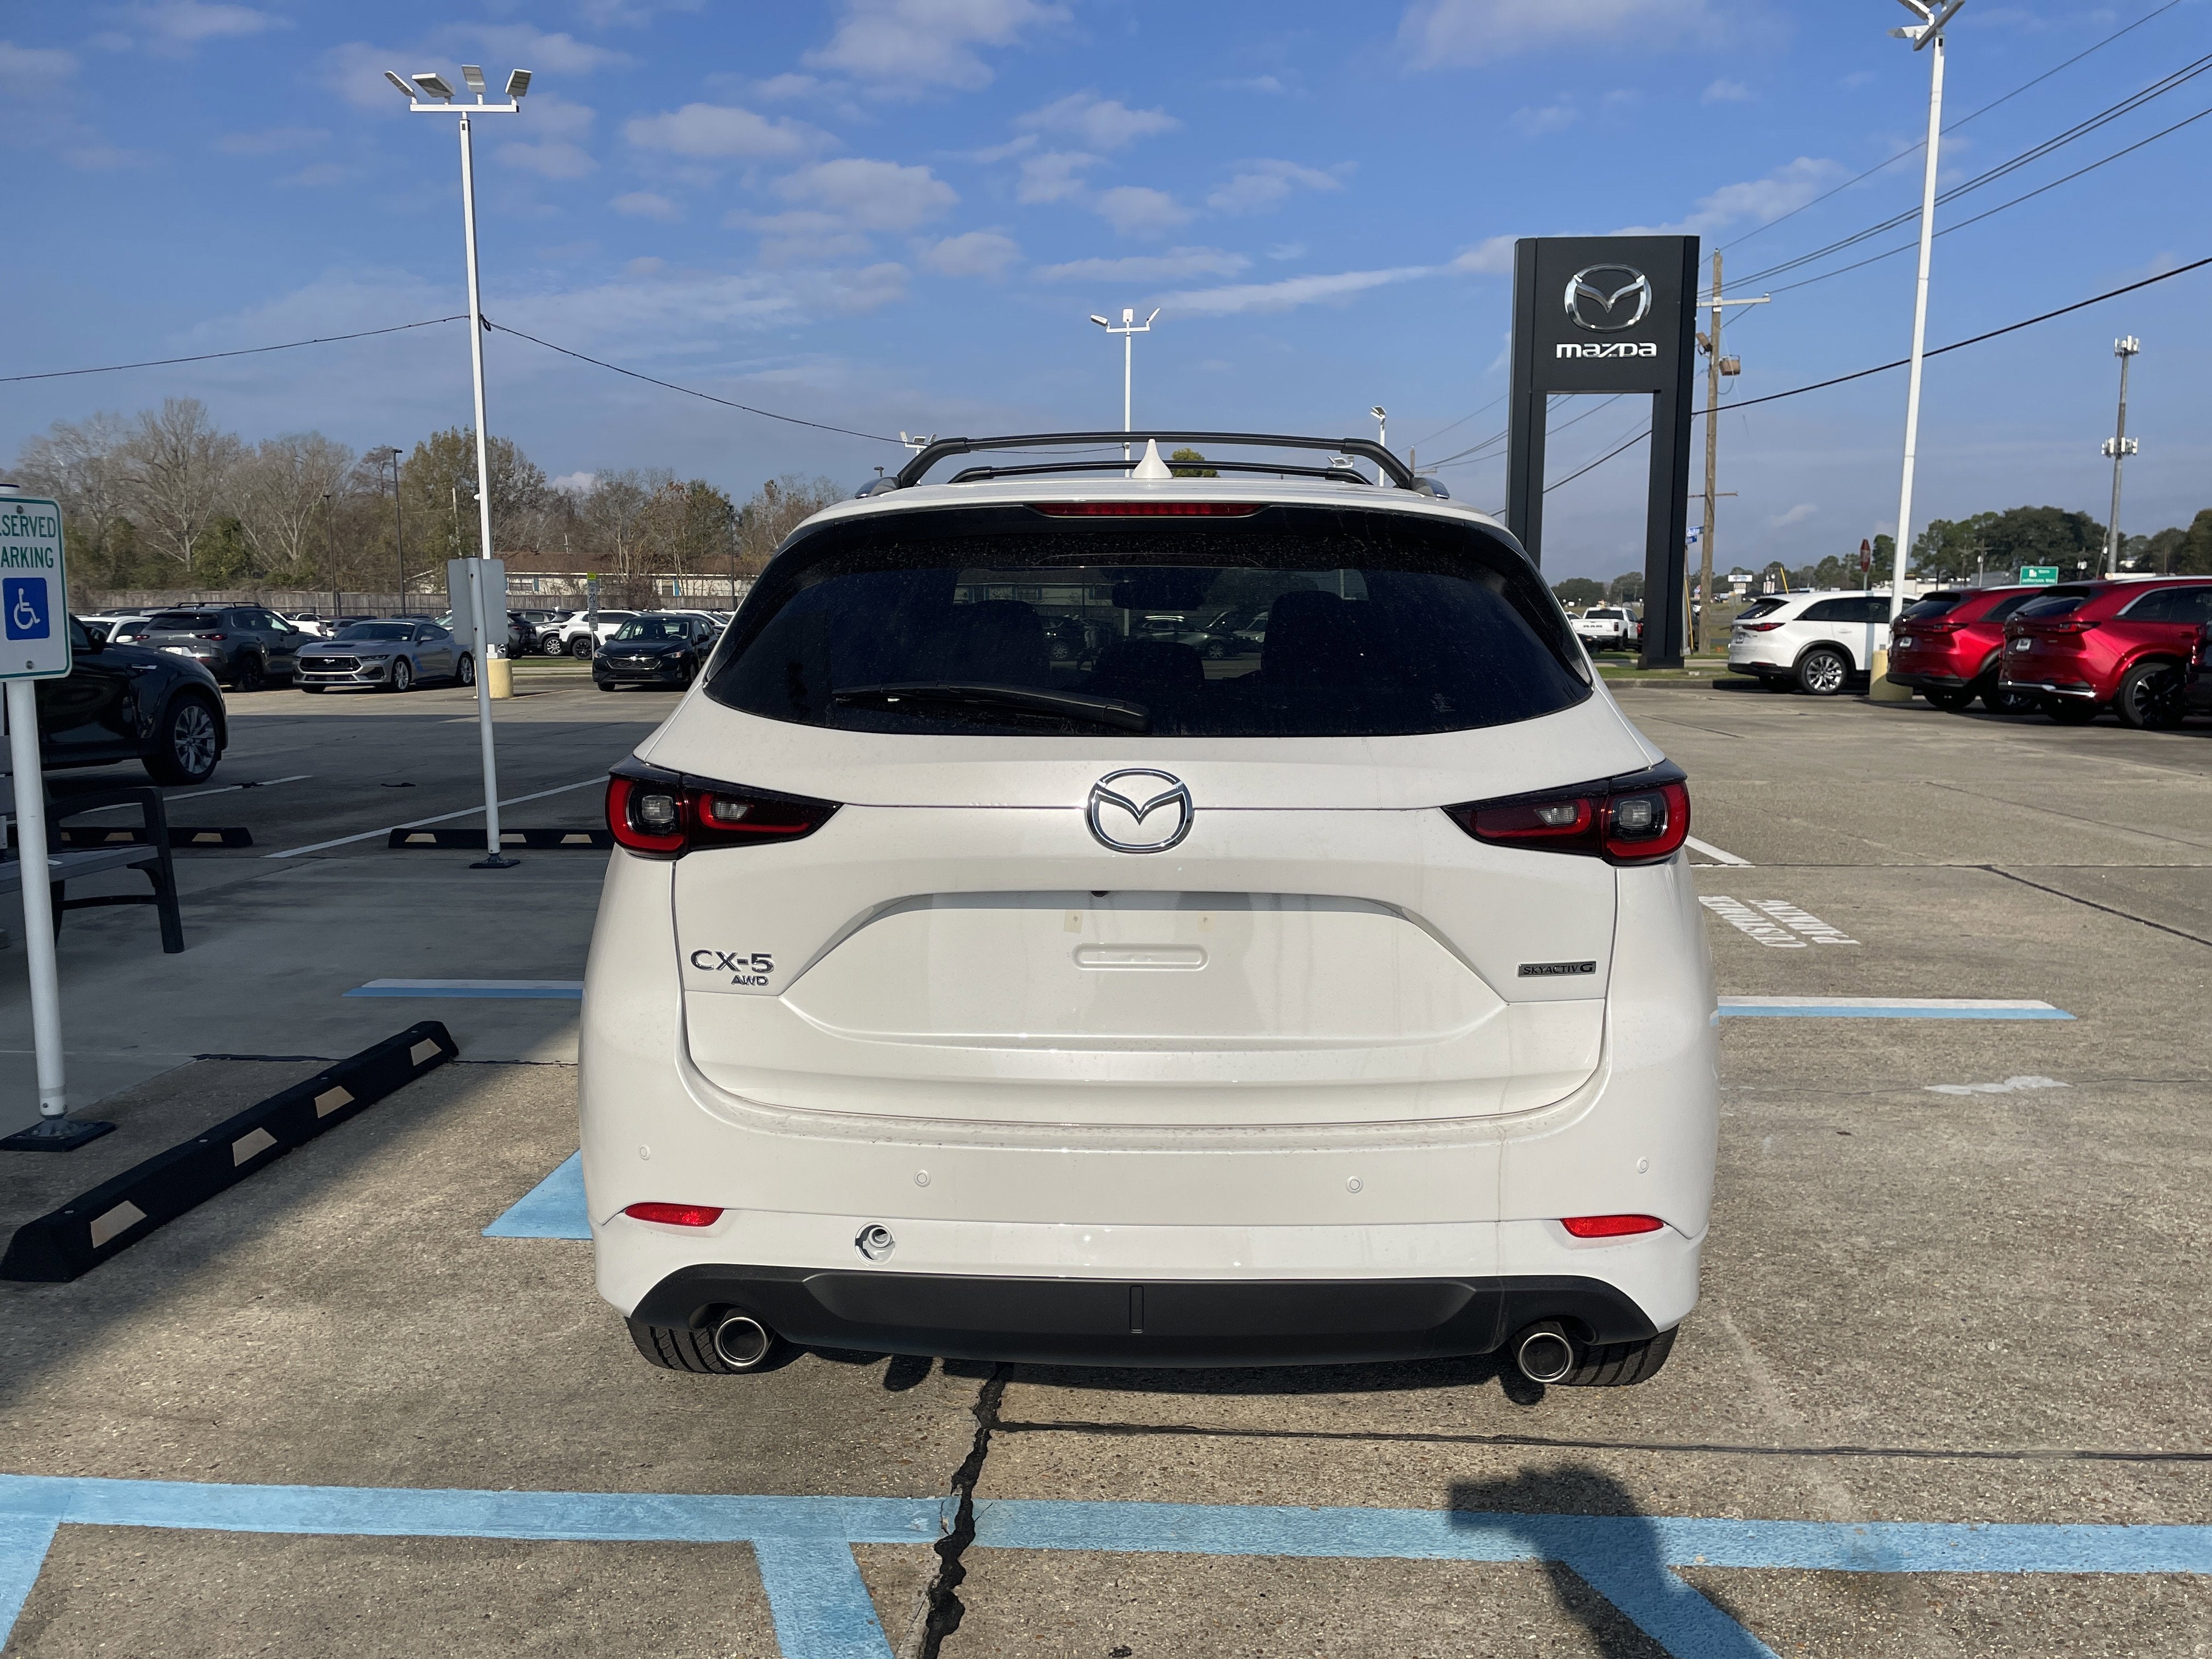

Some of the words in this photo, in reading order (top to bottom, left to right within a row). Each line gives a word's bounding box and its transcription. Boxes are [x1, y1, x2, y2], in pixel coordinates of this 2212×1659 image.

[0, 515, 56, 537] SERVED
[1, 546, 54, 568] ARKING
[589, 593, 596, 603] 20
[1748, 899, 1861, 944] PARKING
[690, 949, 775, 974] CX-5
[731, 974, 769, 986] AWD
